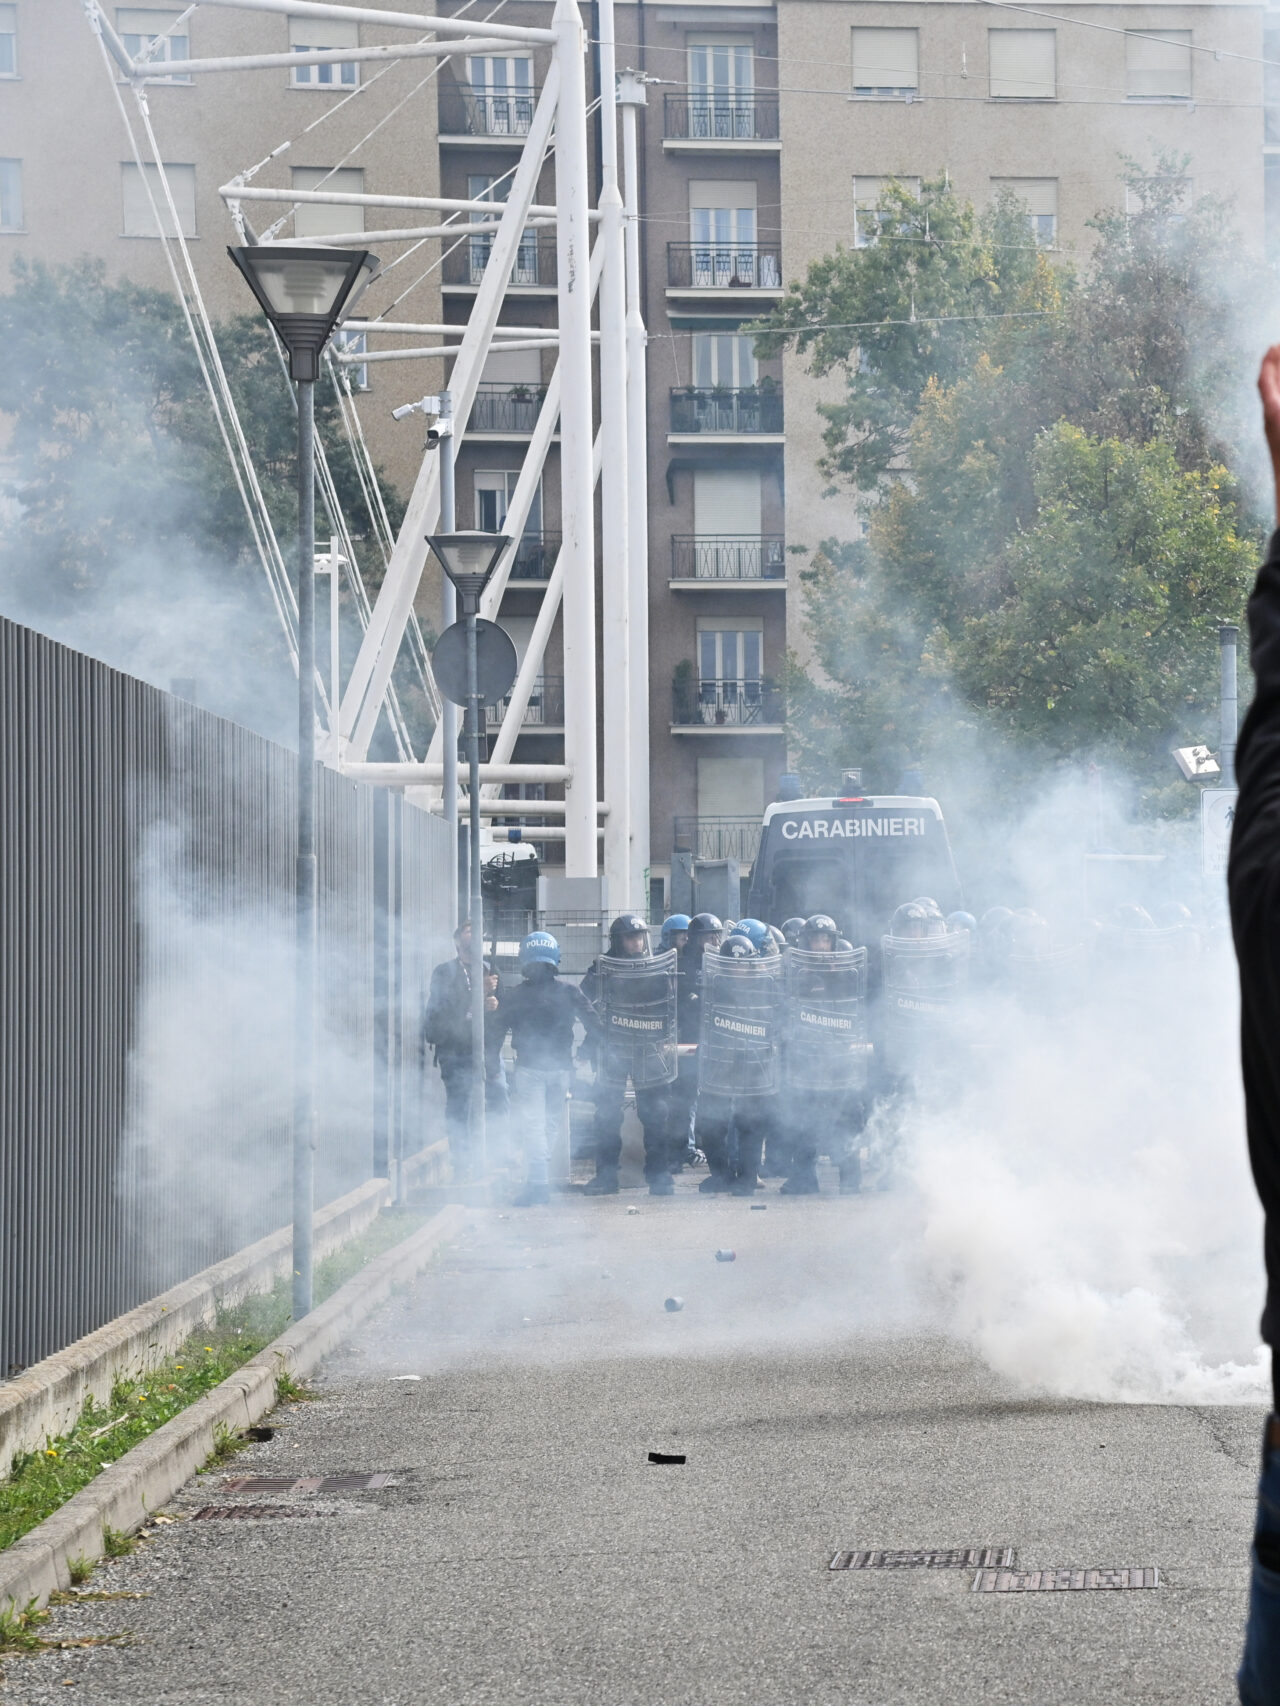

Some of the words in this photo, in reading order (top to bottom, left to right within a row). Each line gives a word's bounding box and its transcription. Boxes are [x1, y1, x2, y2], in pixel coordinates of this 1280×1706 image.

[782, 817, 925, 840] CARABINIERI
[526, 939, 555, 950] POLIZIA
[611, 1015, 663, 1031] CARABINIERI
[714, 1016, 766, 1038] CARABINIERI
[800, 1011, 852, 1030] CARABINIERI
